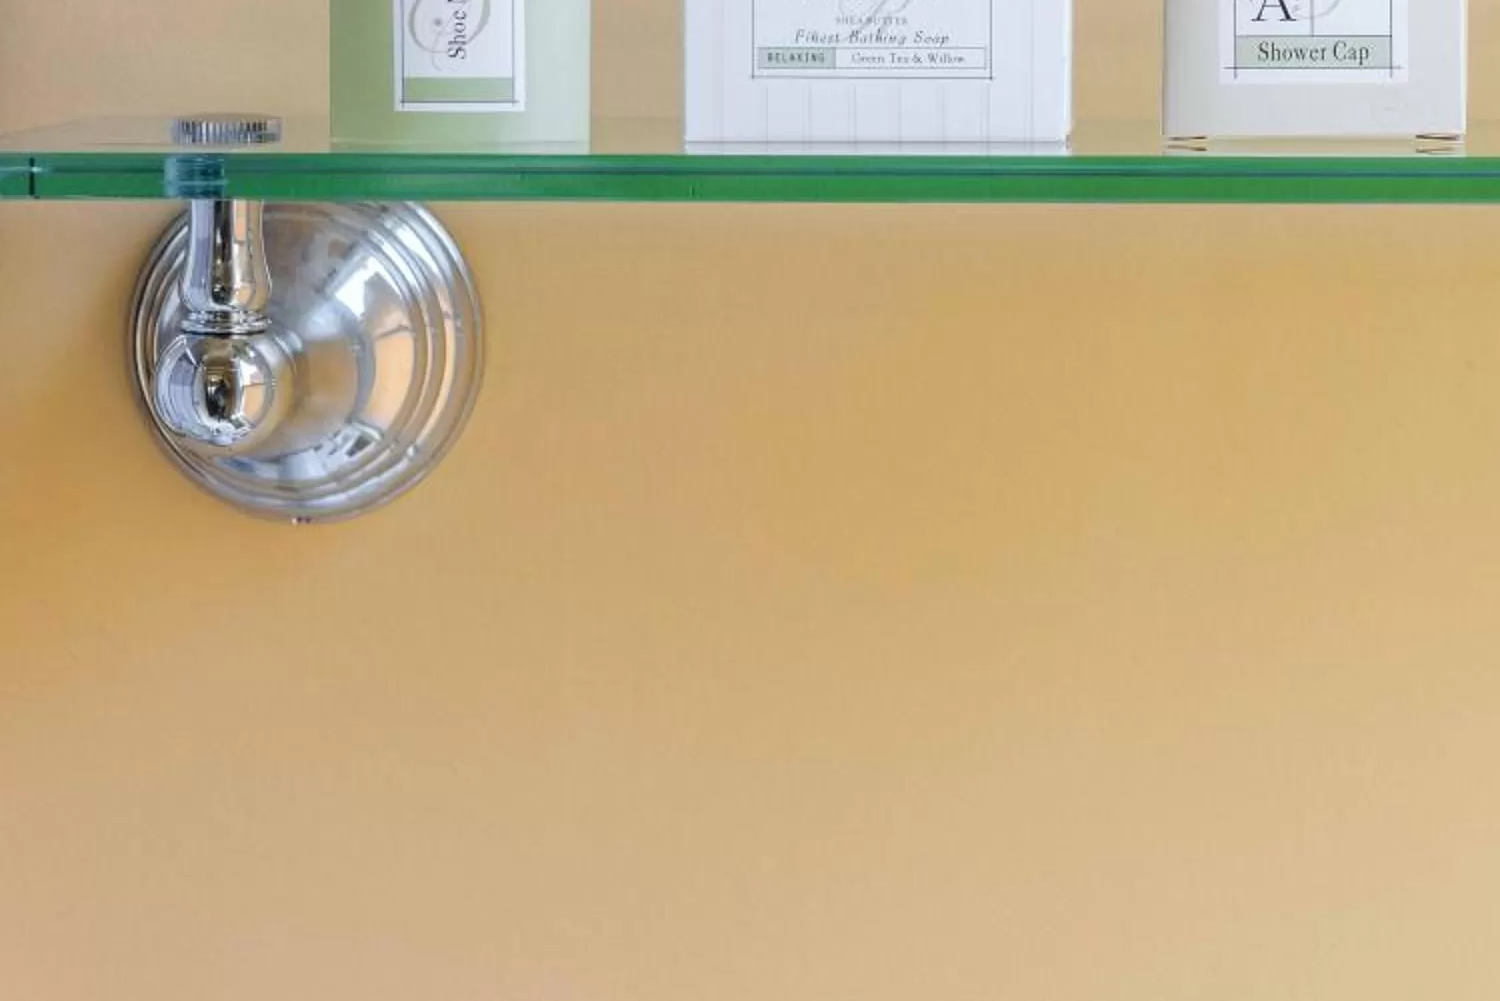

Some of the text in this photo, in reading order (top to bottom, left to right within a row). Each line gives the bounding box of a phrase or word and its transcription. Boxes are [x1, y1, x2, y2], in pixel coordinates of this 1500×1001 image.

[447, 10, 467, 60] Shoe
[794, 28, 841, 45] Finest
[913, 29, 951, 47] Soap
[767, 52, 826, 63] RELAXING
[851, 51, 885, 64] Green
[927, 52, 965, 64] Willow
[1257, 40, 1370, 66] Shower Cap
